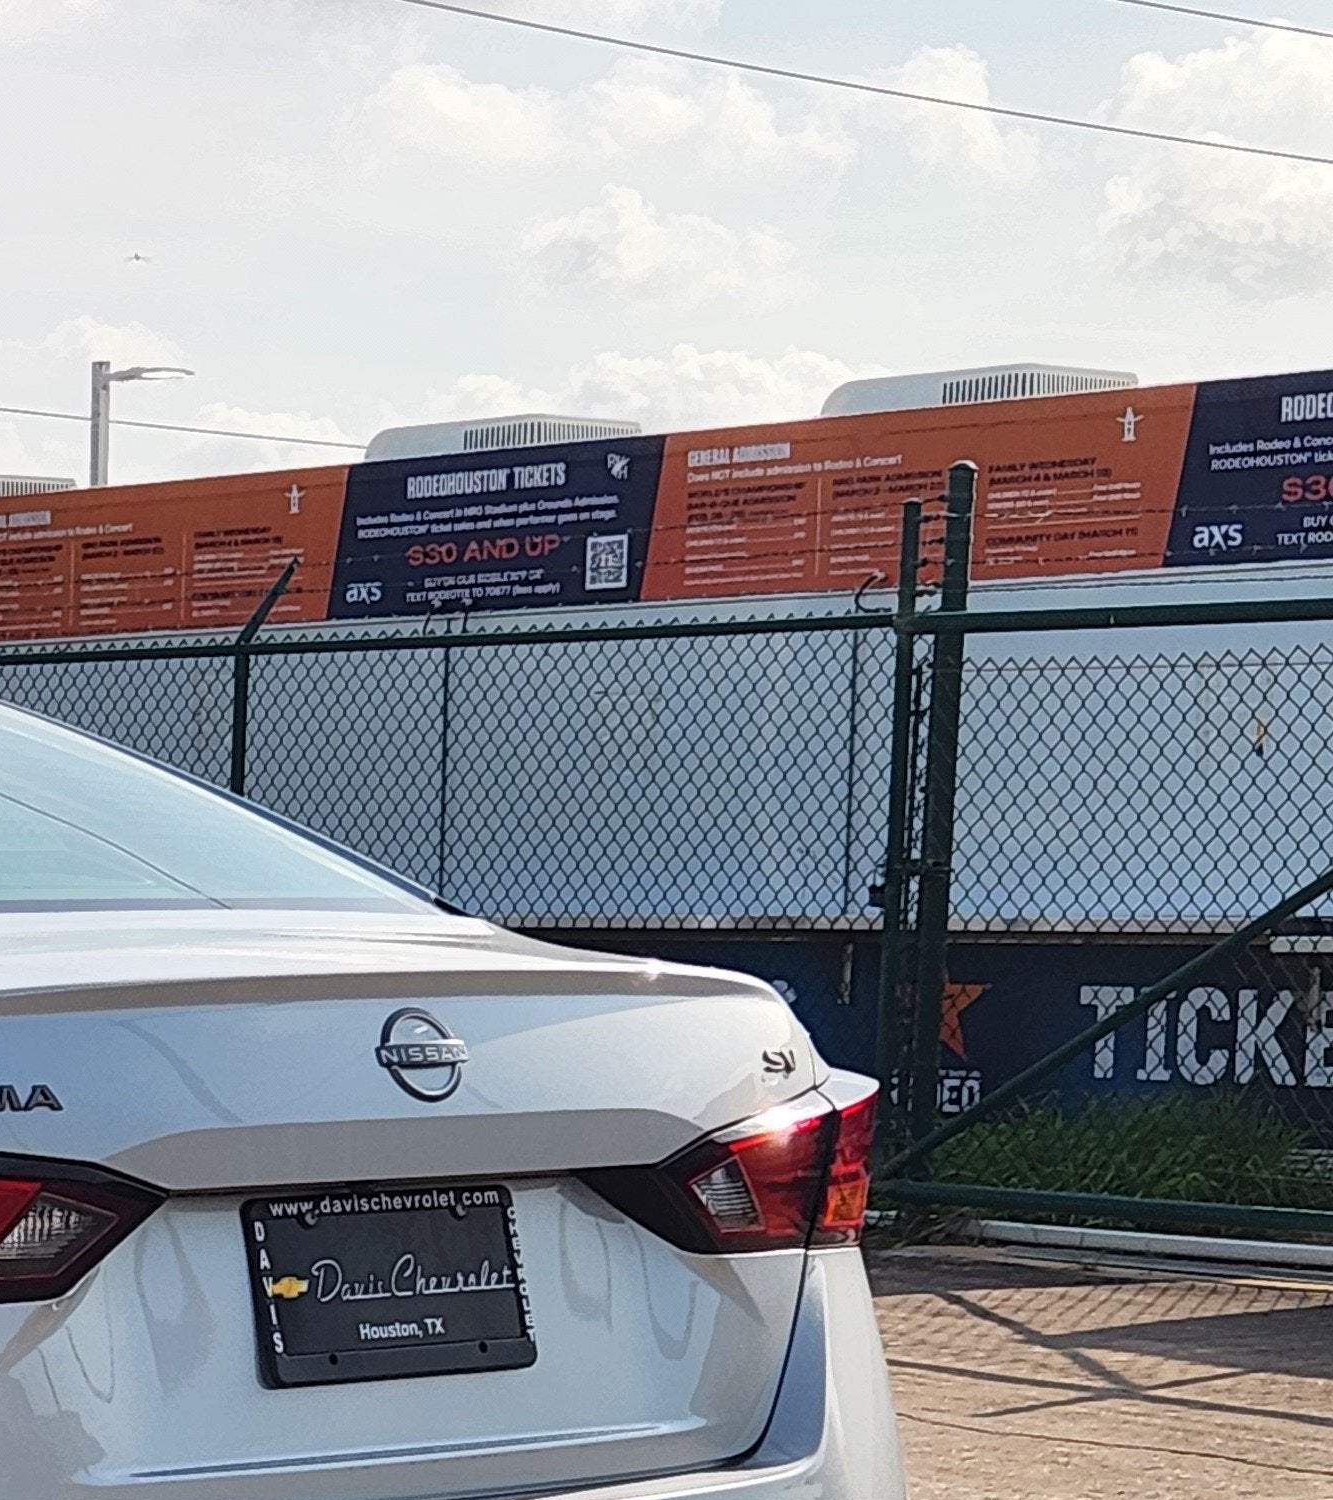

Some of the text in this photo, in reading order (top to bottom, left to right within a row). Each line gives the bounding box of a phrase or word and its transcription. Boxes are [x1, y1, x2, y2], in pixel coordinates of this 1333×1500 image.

[513, 462, 566, 489] TICKETS
[1282, 474, 1333, 501] $3
[463, 537, 519, 562] AND
[525, 533, 560, 557] UP
[345, 582, 382, 604] axs
[380, 1045, 468, 1064] NISSAN
[254, 1219, 284, 1354] DAVIS
[310, 1253, 515, 1302] Davis Chevrolet
[359, 1317, 445, 1340] Houston, TX
